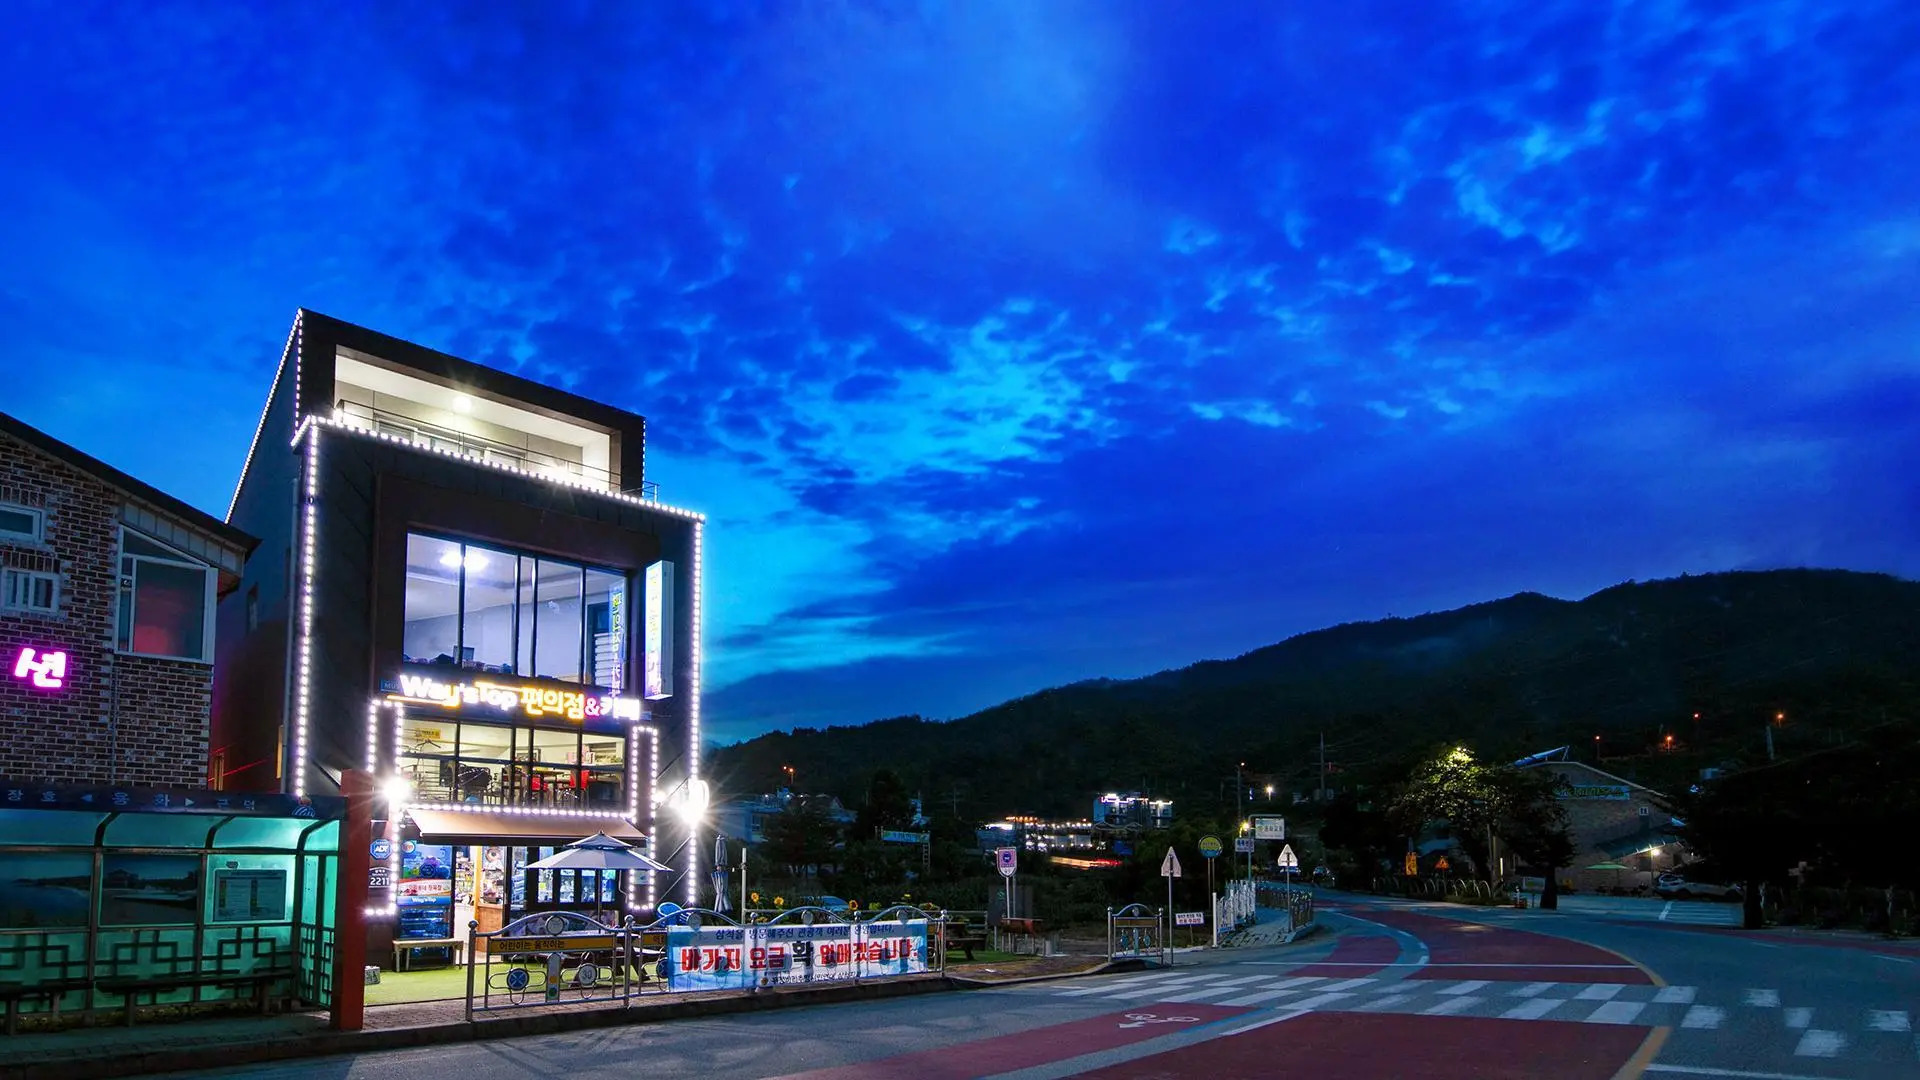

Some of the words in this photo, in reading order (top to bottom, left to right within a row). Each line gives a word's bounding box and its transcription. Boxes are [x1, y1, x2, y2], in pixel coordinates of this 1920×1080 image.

[375, 845, 389, 853] ADT
[370, 877, 390, 886] 2211
[716, 929, 745, 940] 삼척을
[749, 928, 794, 940] 방문해주신
[797, 927, 824, 938] 관광객
[499, 940, 533, 951] 어린이는
[534, 939, 565, 950] 움직이는
[681, 947, 741, 972] 바가지
[749, 946, 785, 968] 요금
[791, 940, 814, 966] 확
[819, 938, 919, 966] 없애겠습니다.
